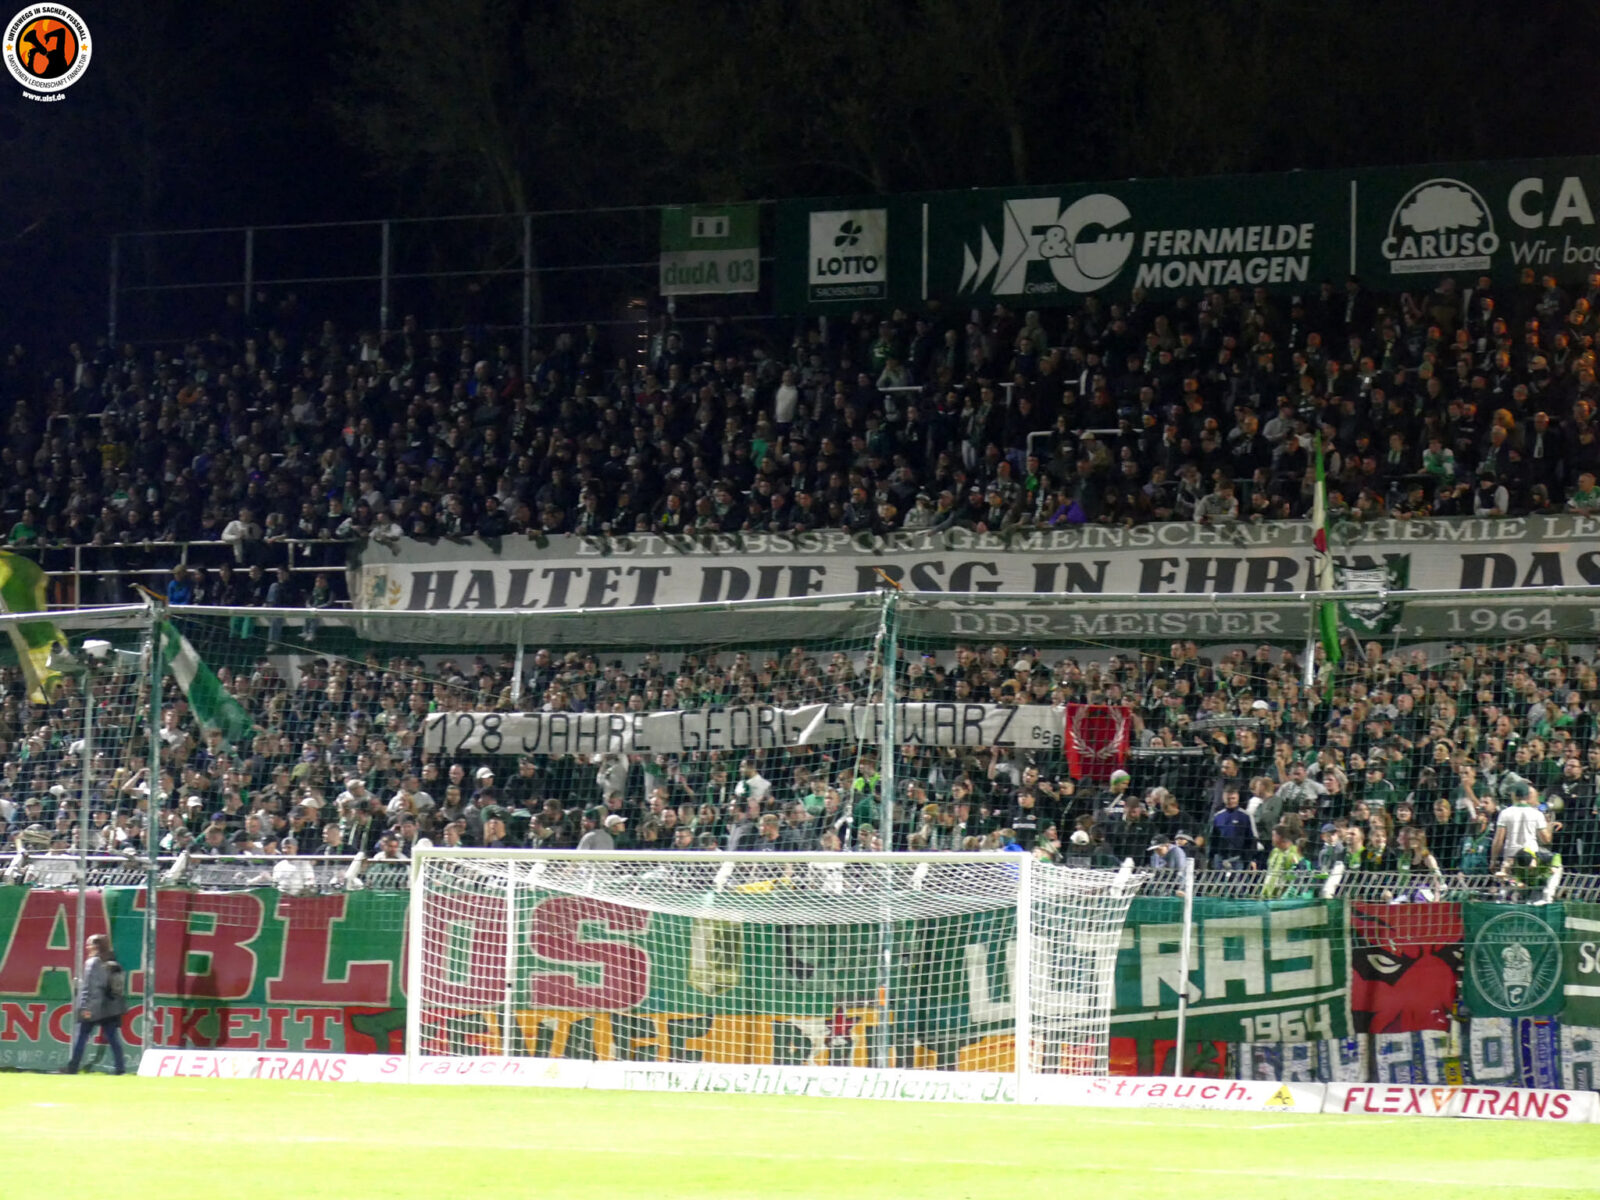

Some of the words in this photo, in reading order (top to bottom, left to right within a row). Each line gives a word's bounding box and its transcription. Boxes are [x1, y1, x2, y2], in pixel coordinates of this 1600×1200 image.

[1508, 176, 1596, 229] CA
[1142, 223, 1315, 257] FERNMELDE
[1381, 231, 1499, 260] CARUSO
[1510, 240, 1557, 265] Wir
[817, 255, 878, 277] LOTTO
[1135, 255, 1311, 288] MONTAGEN
[1331, 517, 1527, 544] CHEMIE
[405, 564, 671, 611] HALTET
[700, 561, 826, 606] DIE
[853, 560, 1003, 608] BSG
[1028, 559, 1111, 606] IN
[951, 612, 1284, 635] DDR-MEISTER
[429, 713, 503, 752] 128
[523, 712, 651, 753] JAHRE
[680, 705, 801, 750] GEORG
[1579, 941, 1600, 974] S
[1240, 1003, 1334, 1043] 1964
[157, 1055, 227, 1078] FLEX
[256, 1055, 347, 1080] TRANS
[380, 1056, 526, 1075] Srauch.
[1343, 1087, 1426, 1114] FLEX
[1460, 1087, 1572, 1120] TRANS
